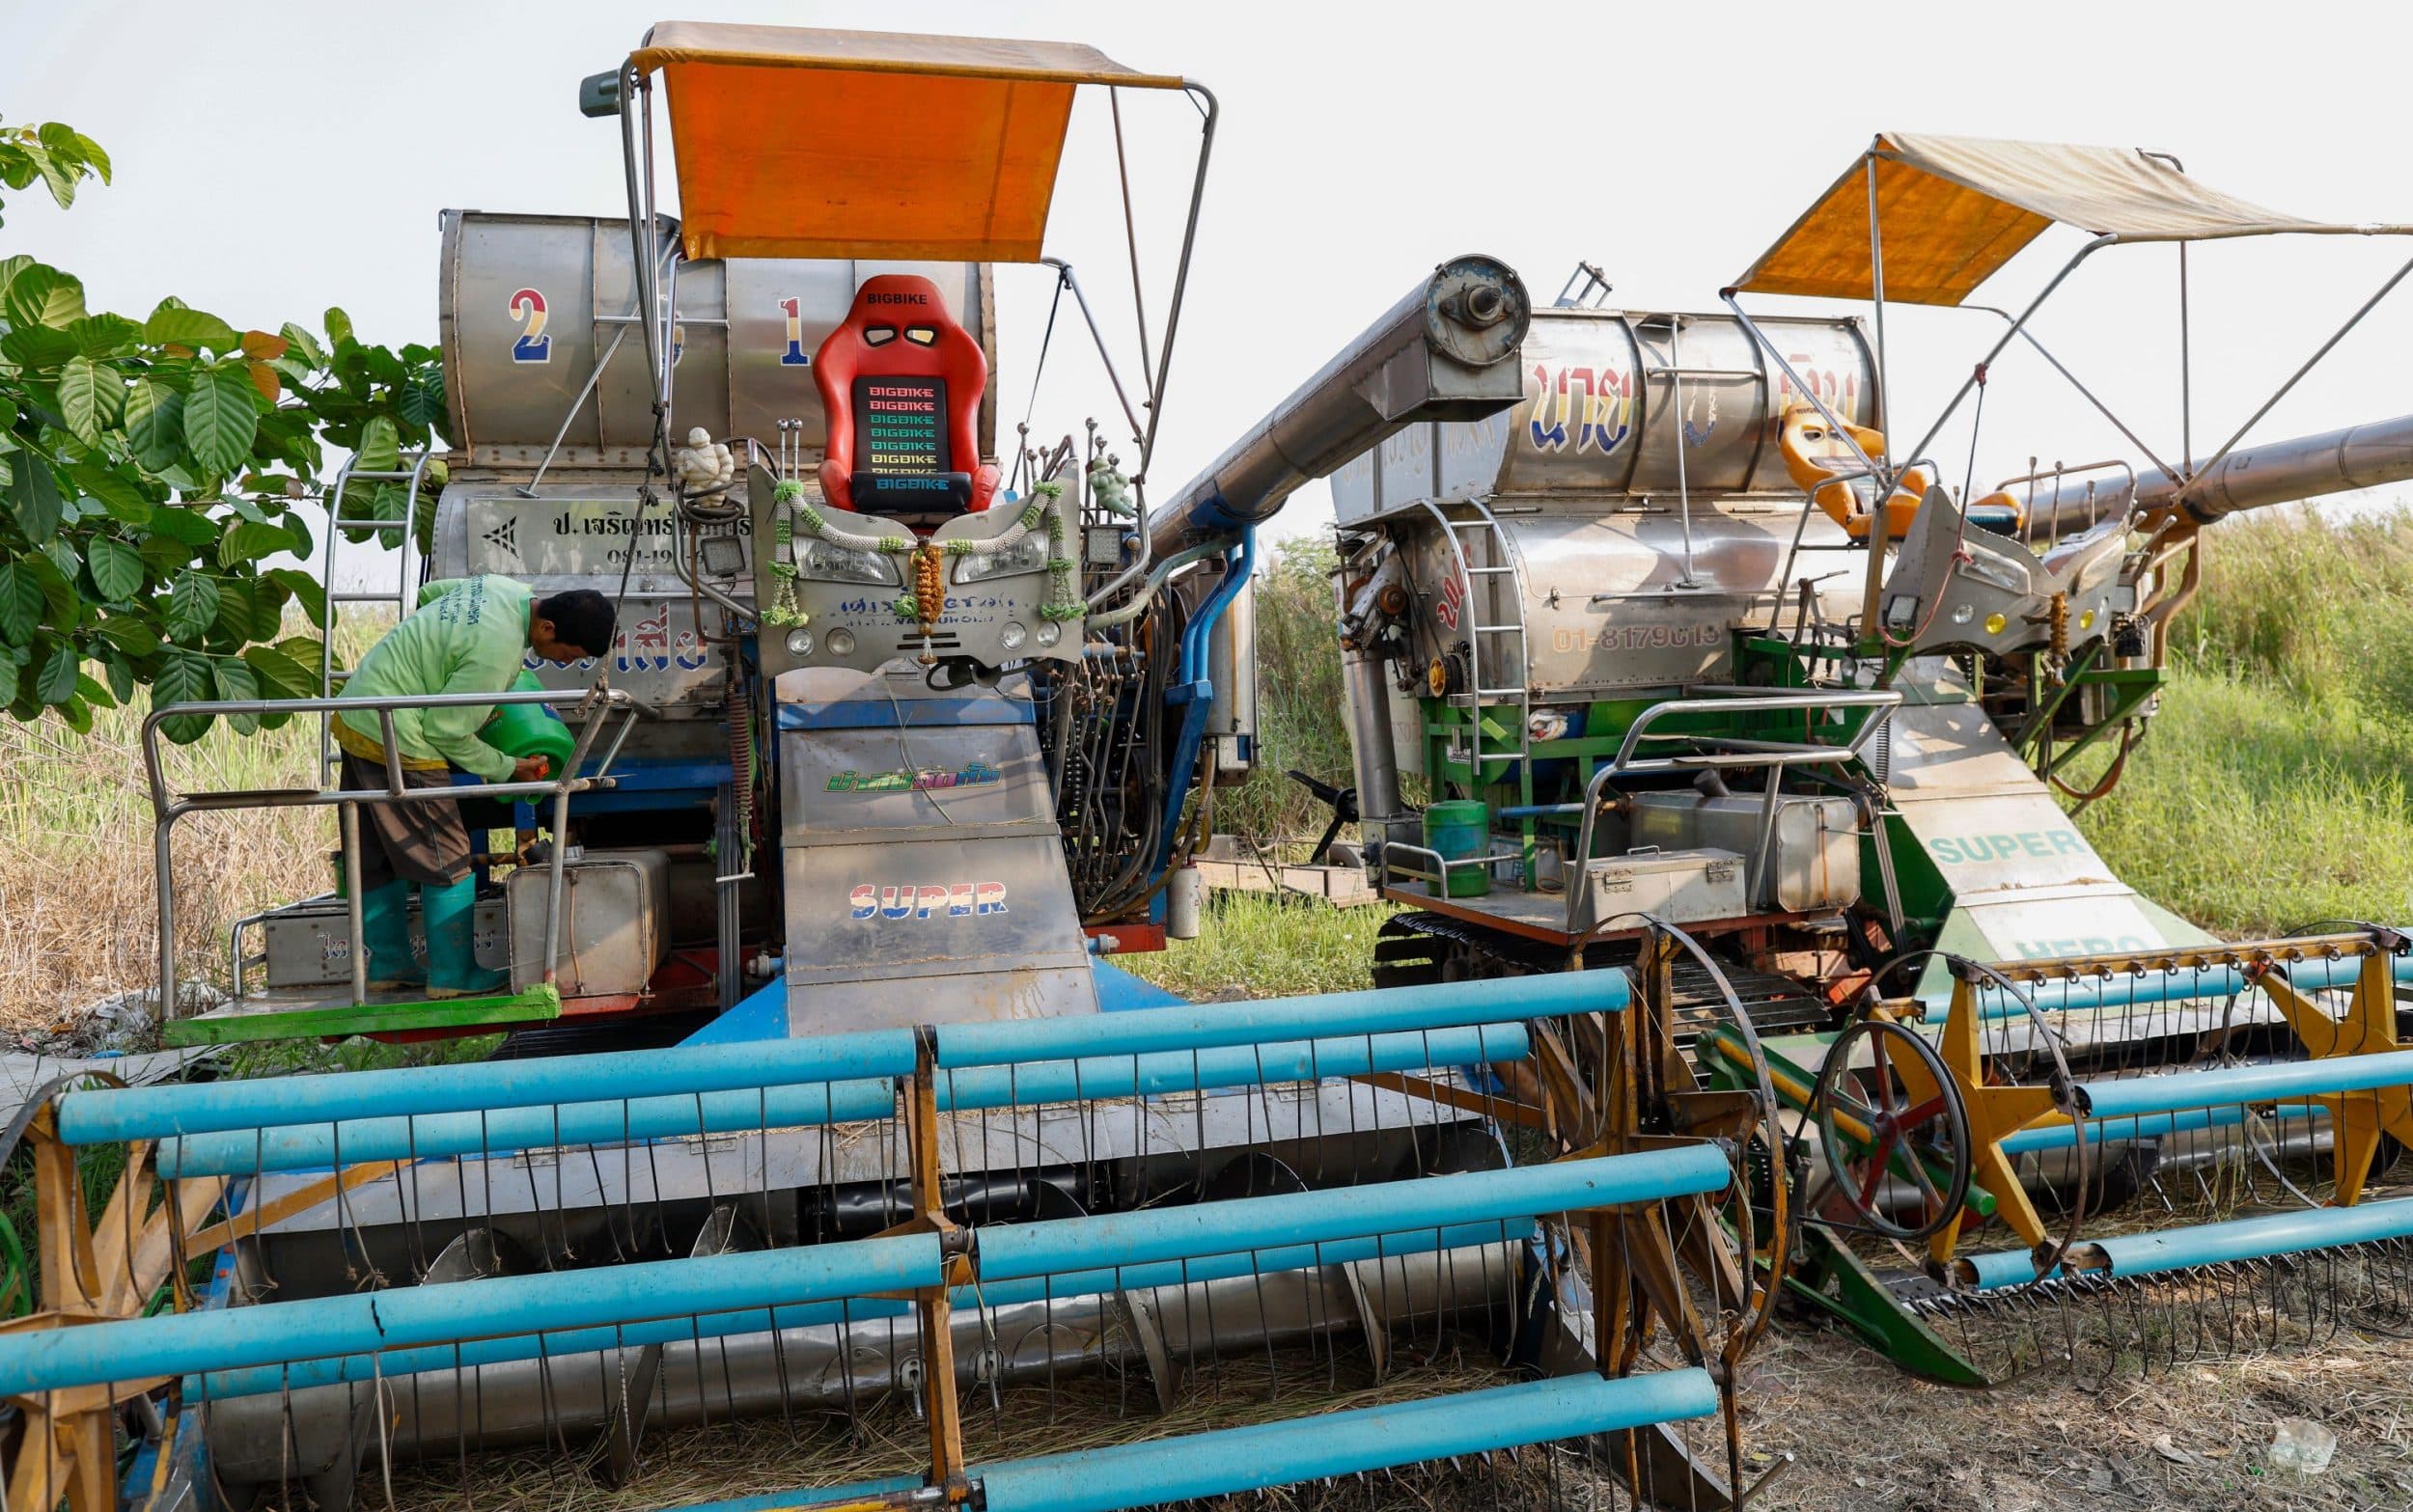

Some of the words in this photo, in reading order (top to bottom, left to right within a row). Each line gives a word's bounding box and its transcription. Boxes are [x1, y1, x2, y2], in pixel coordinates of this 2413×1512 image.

[867, 293, 927, 304] BIGBIKE
[508, 287, 551, 364] 2
[778, 296, 811, 367] 1
[869, 387, 934, 398] BIGBIKE
[870, 400, 934, 411] BIGBIKE
[1530, 364, 1631, 455] นาย
[871, 415, 934, 425] BIGBIKE
[871, 428, 935, 438] BIGBIKE
[871, 441, 935, 451] BIGBIKE
[872, 454, 937, 464] BIGBIKE
[876, 479, 950, 490] BIGBIKE
[1929, 829, 2087, 865] SUPER
[850, 881, 1010, 921] SUPER
